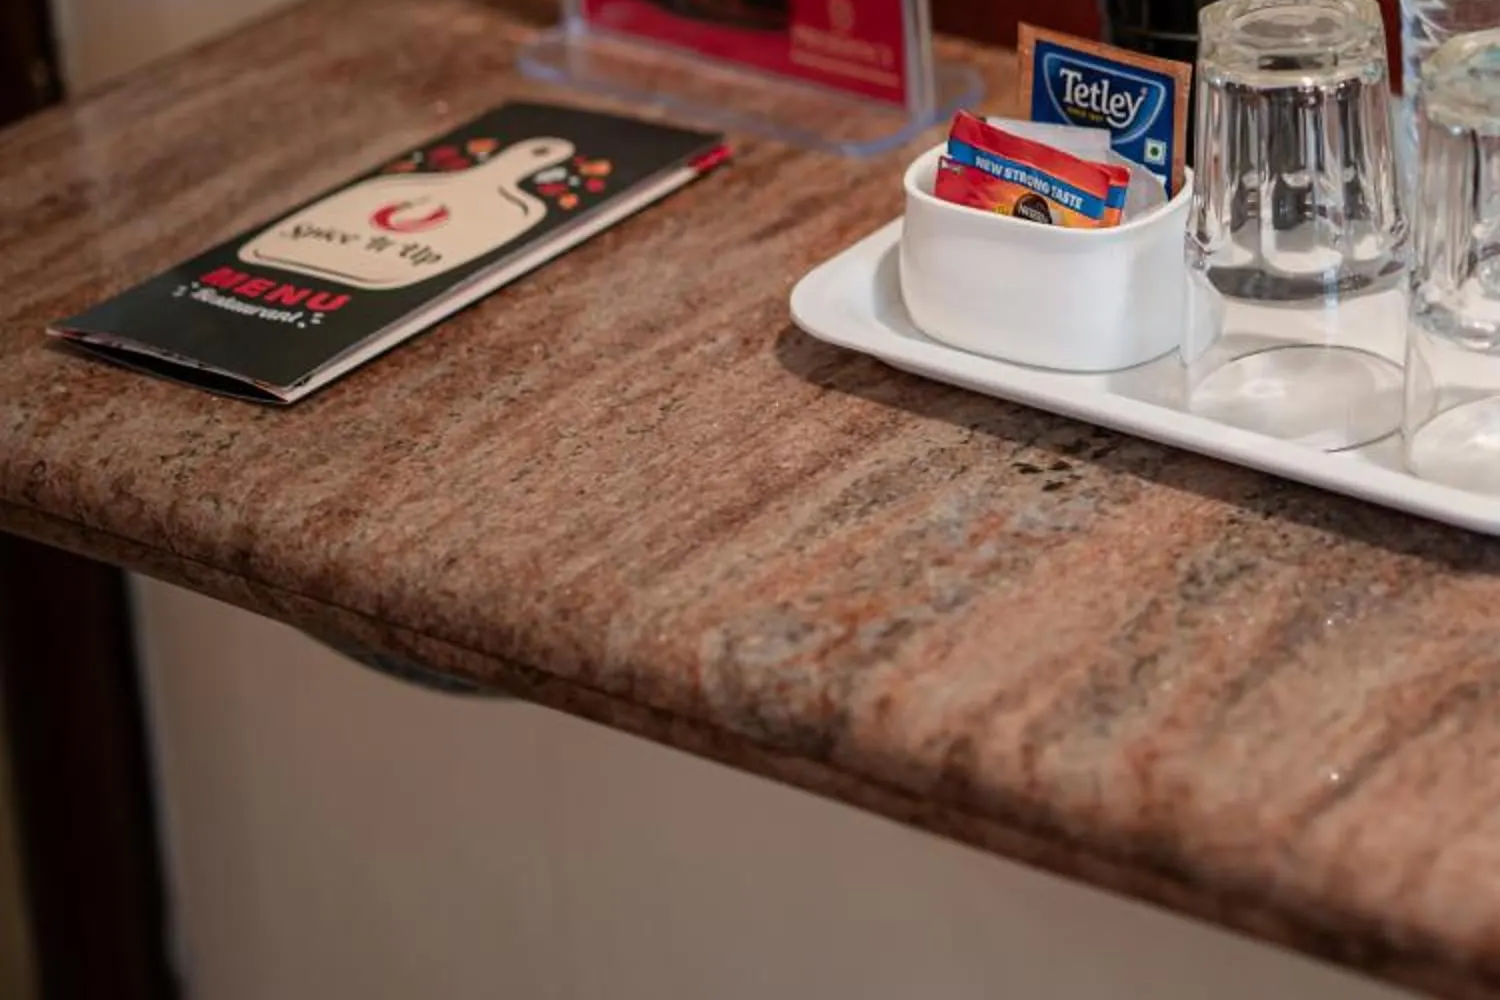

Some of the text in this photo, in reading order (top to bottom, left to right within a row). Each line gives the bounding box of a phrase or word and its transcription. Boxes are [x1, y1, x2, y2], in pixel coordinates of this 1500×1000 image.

[1059, 67, 1146, 128] Tetley
[975, 156, 1004, 175] NEW
[1003, 166, 1050, 195] STRONG
[1051, 185, 1084, 210] TASTE
[201, 265, 352, 311] MENU
